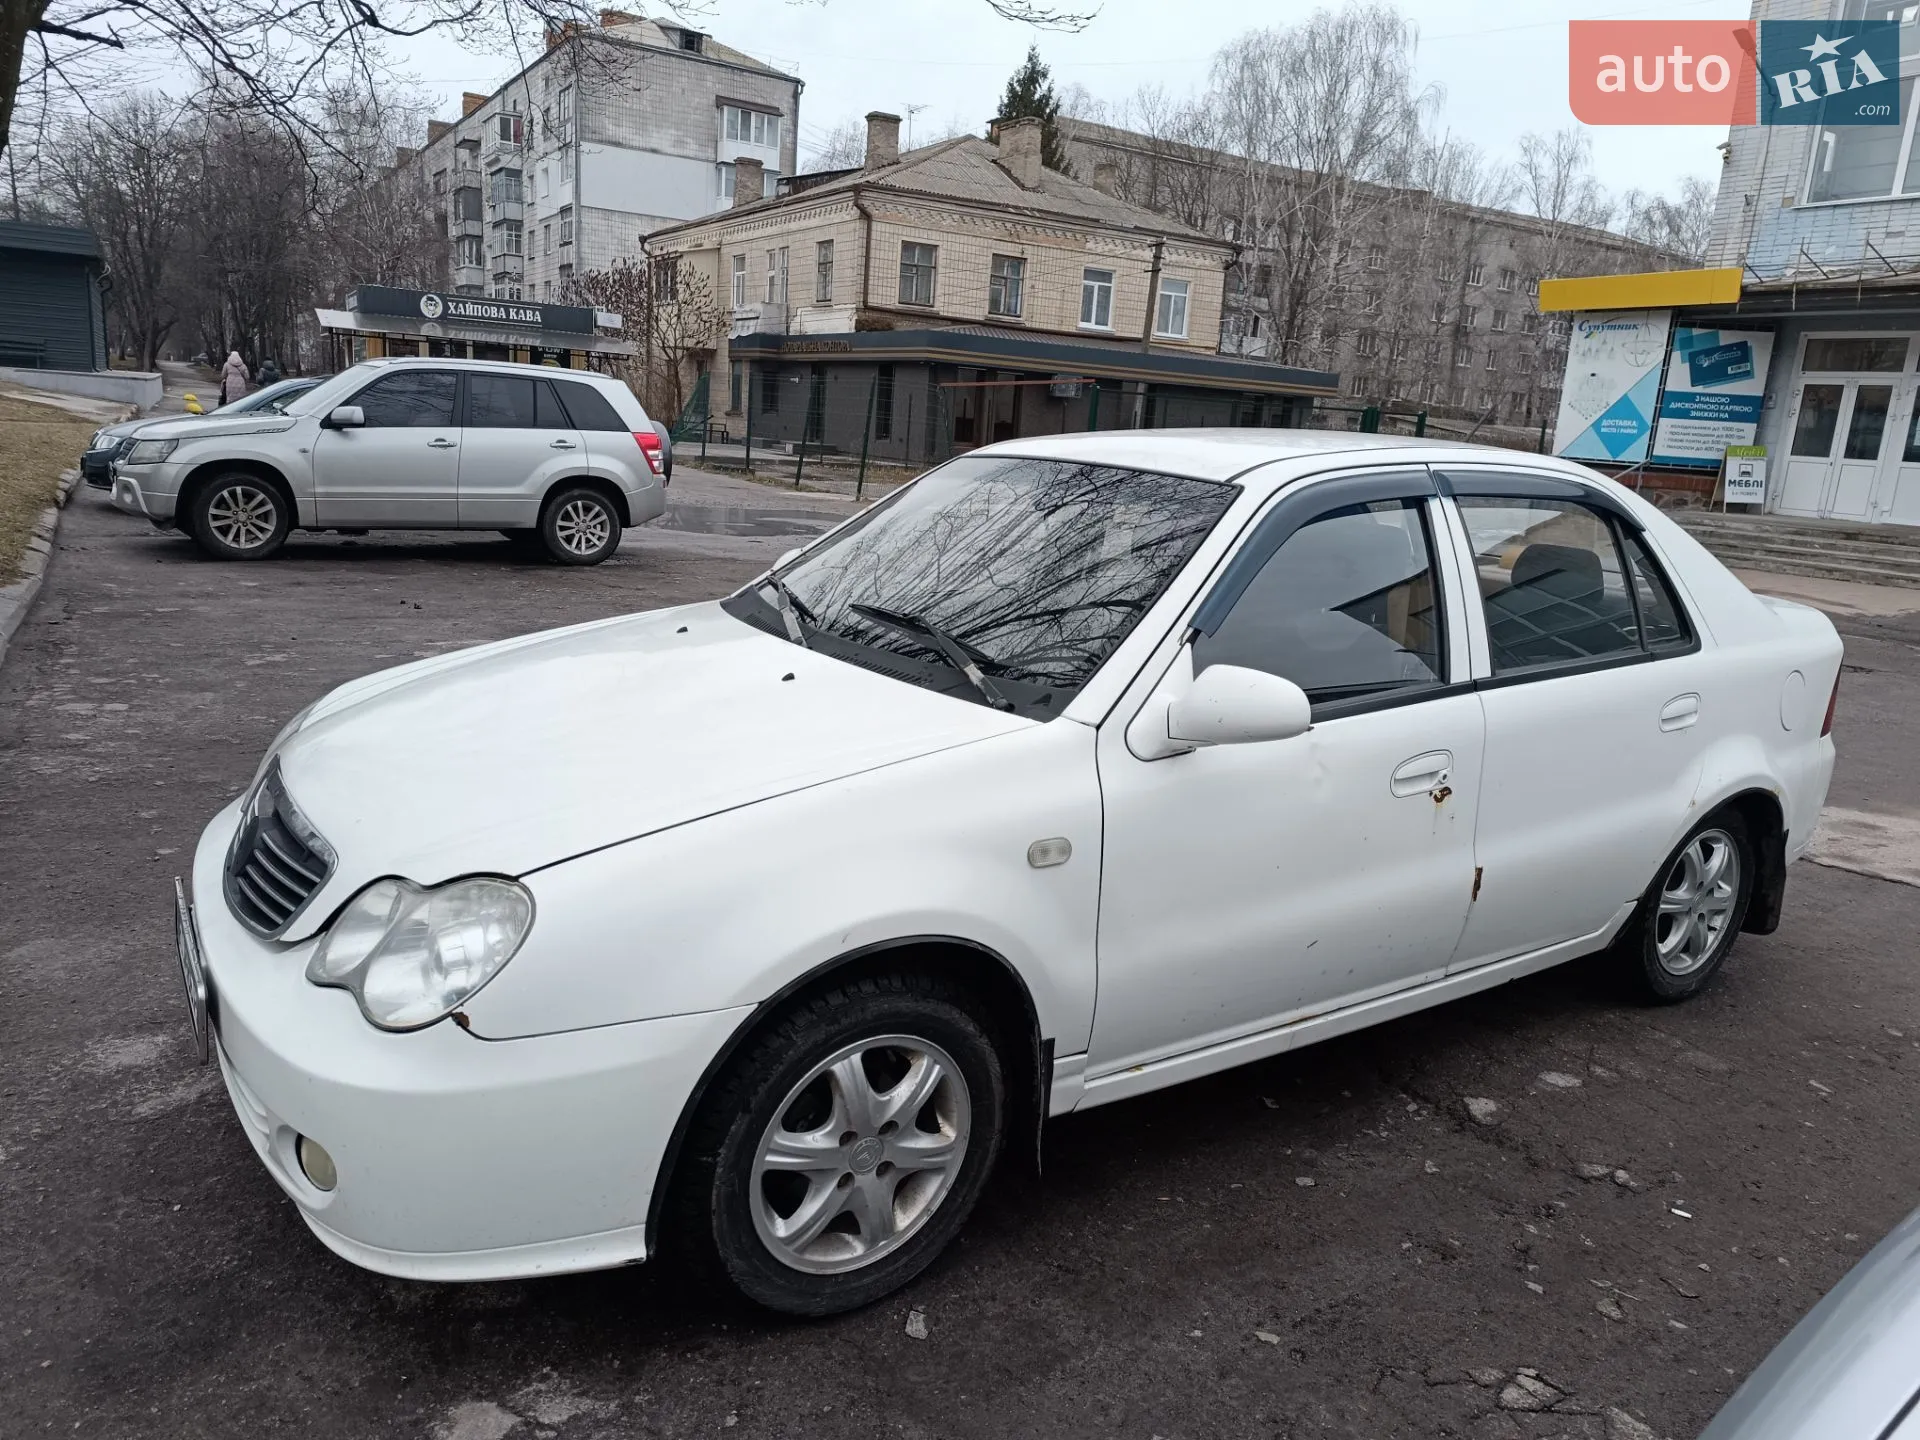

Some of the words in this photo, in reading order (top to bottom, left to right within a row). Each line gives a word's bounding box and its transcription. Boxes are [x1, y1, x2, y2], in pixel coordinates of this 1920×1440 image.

[447, 301, 507, 319] ХАЙПОВА
[509, 307, 542, 323] КАВА
[1578, 320, 1640, 336] Супутник
[1700, 395, 1730, 404] НАШОЮ
[1669, 402, 1720, 411] ДИСКОНТНОЮ
[1719, 405, 1753, 413] КАРТКОЮ
[1689, 410, 1719, 418] ЗНИЖКИ
[1727, 479, 1763, 488] МЕБЛІ
